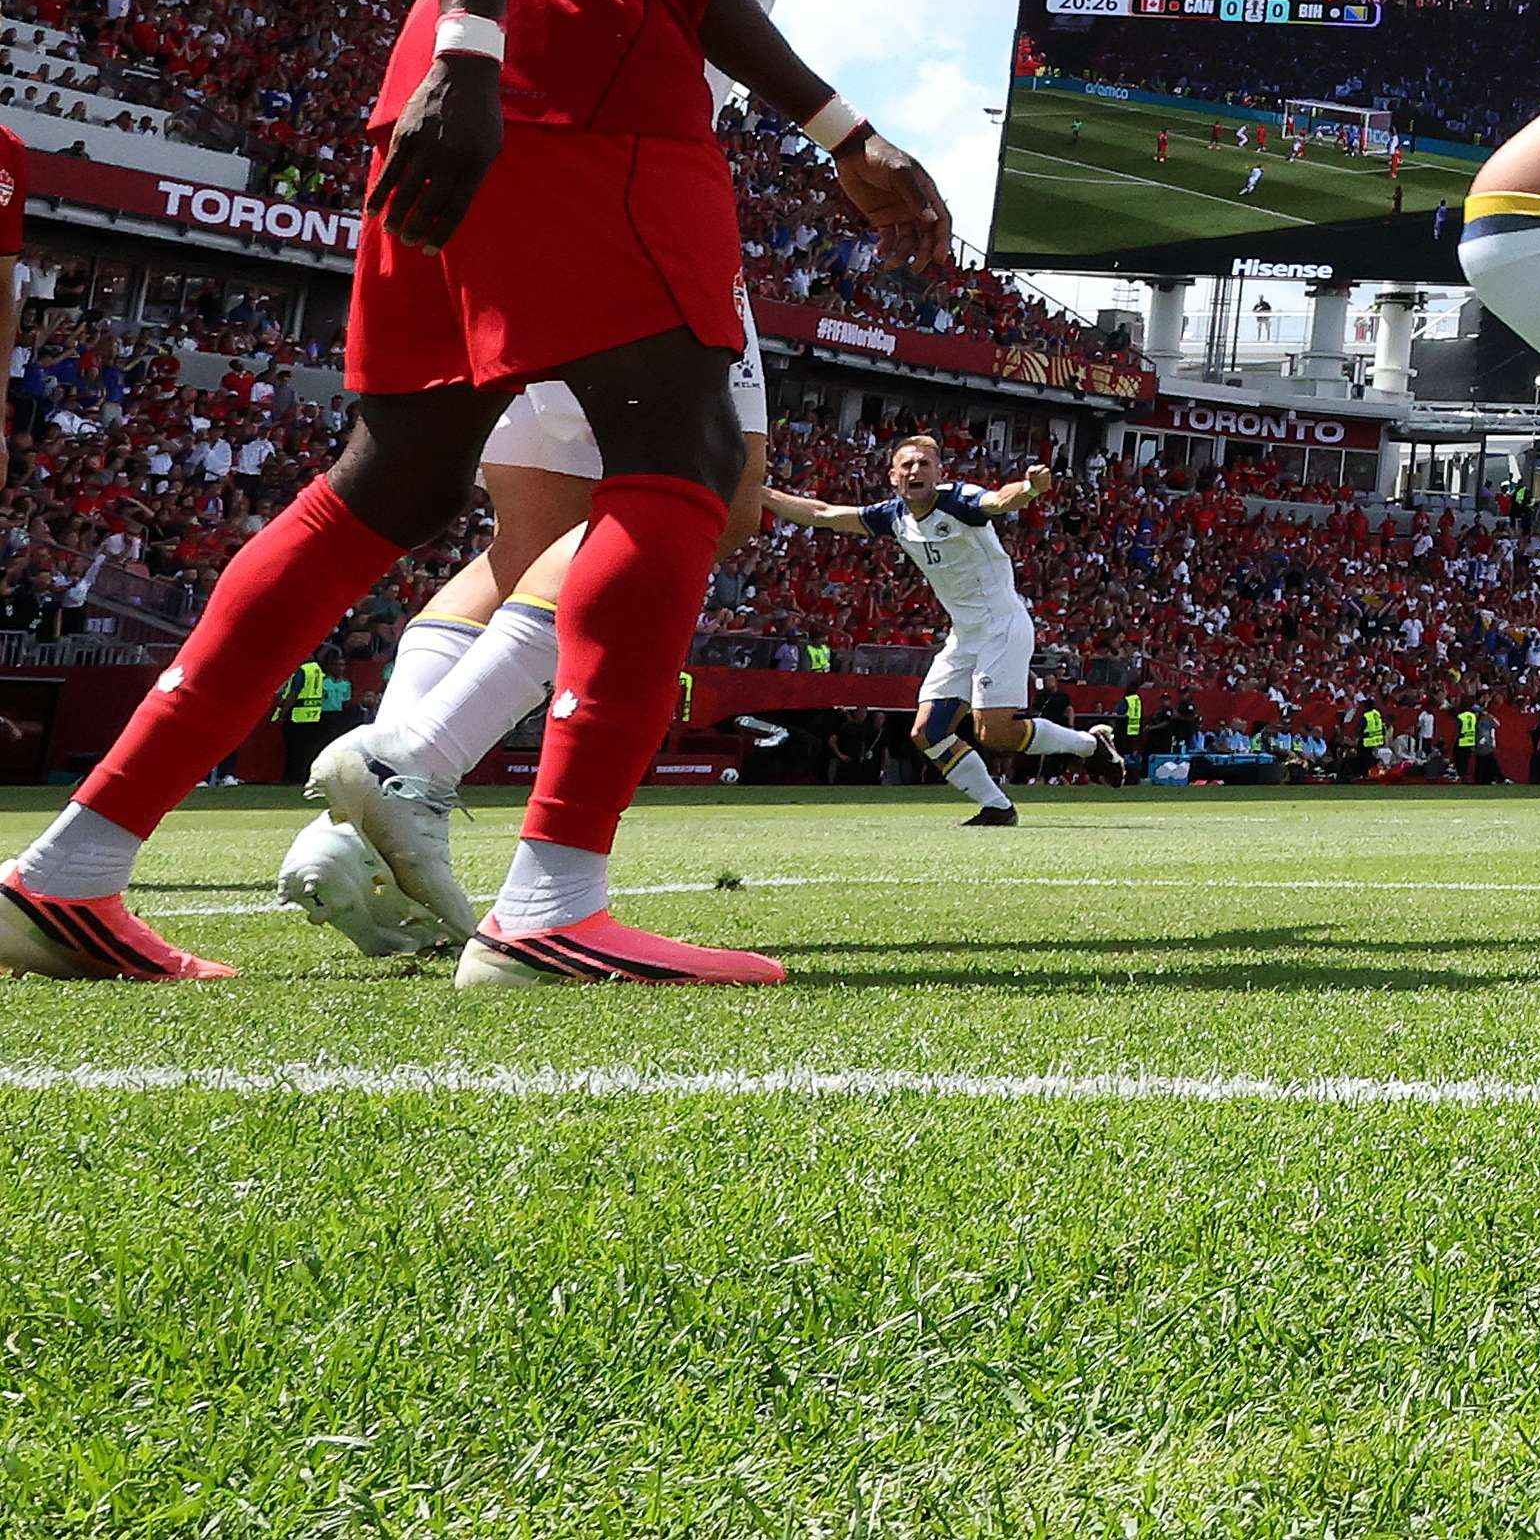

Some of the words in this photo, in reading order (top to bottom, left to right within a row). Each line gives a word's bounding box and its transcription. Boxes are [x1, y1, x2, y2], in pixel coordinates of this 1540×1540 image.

[1184, 0, 1214, 14] CAN
[1299, 4, 1323, 19] BIH
[158, 180, 362, 250] TORONT
[1232, 259, 1333, 279] Hisense
[1167, 401, 1346, 444] TORONTO
[923, 541, 942, 565] 15
